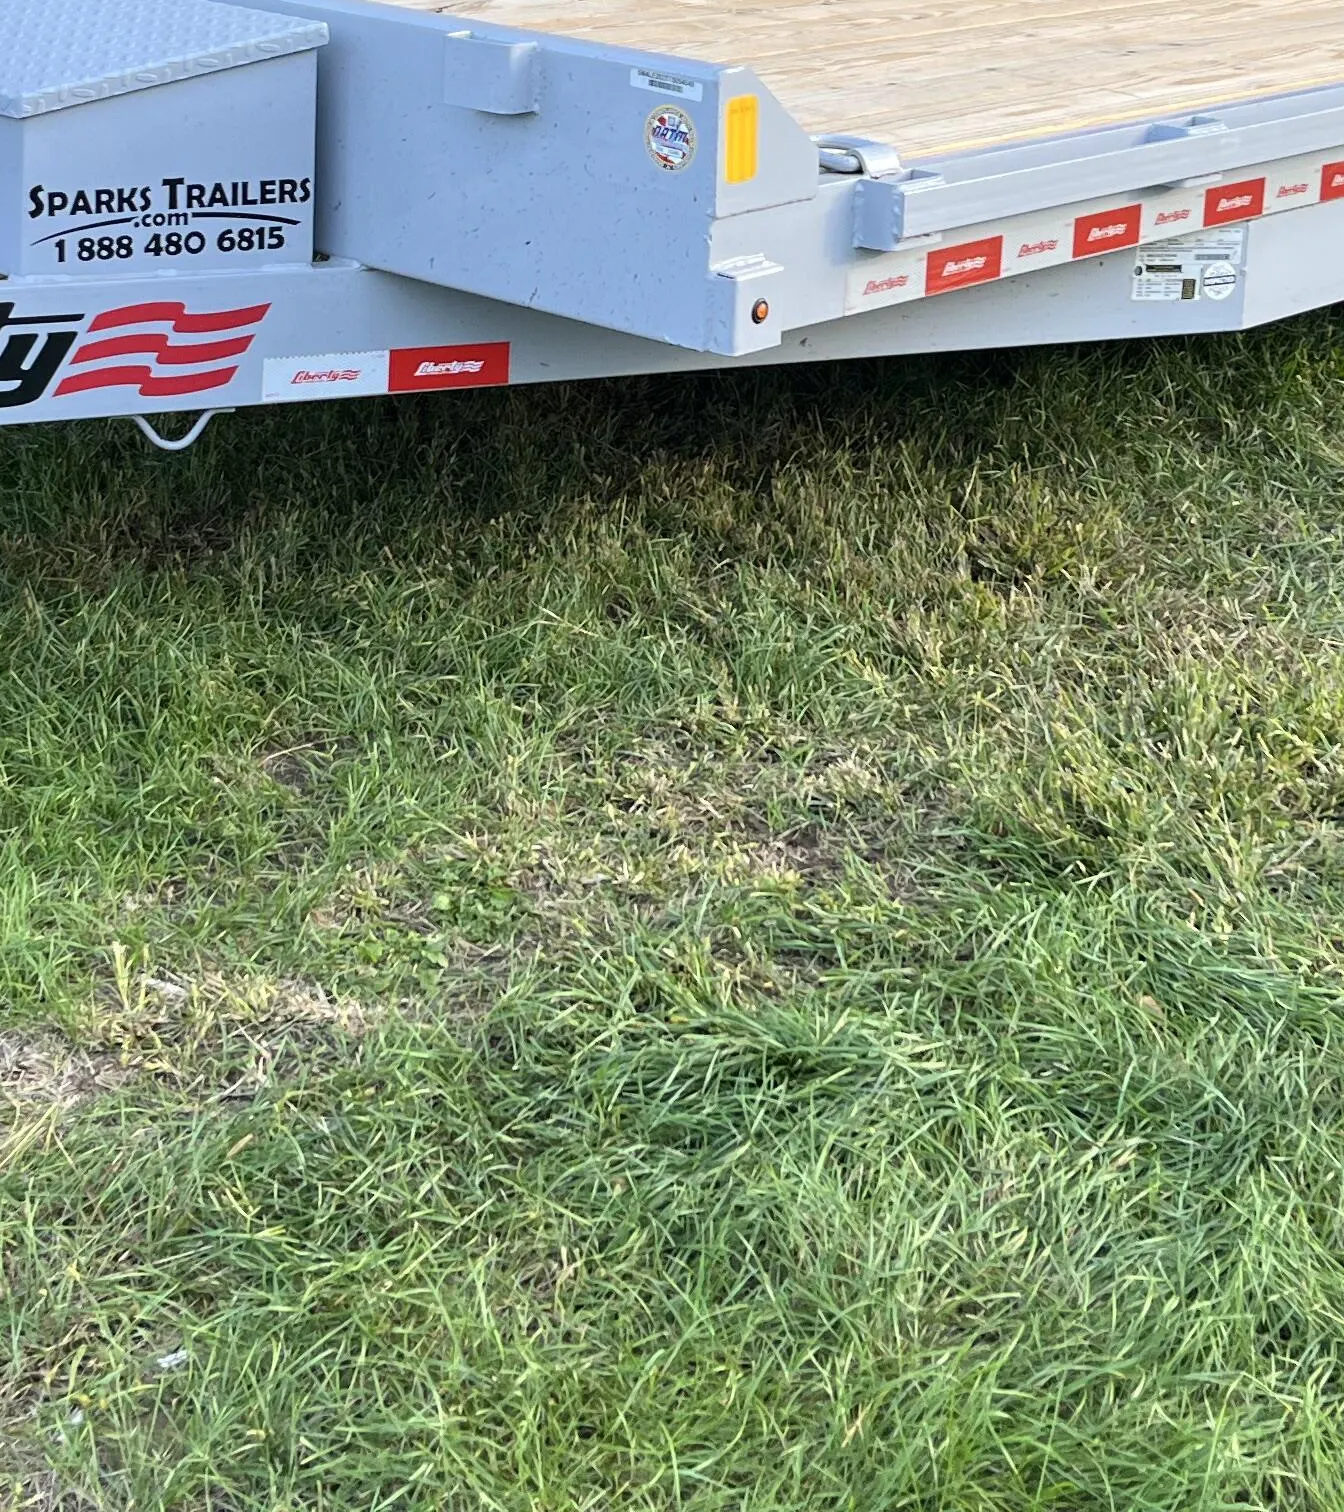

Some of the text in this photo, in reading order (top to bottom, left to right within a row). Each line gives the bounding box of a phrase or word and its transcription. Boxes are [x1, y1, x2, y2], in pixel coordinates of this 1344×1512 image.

[28, 178, 311, 219] SPARKS TRAILERS
[133, 211, 189, 228] .com
[55, 226, 285, 262] 1 888 480 6815
